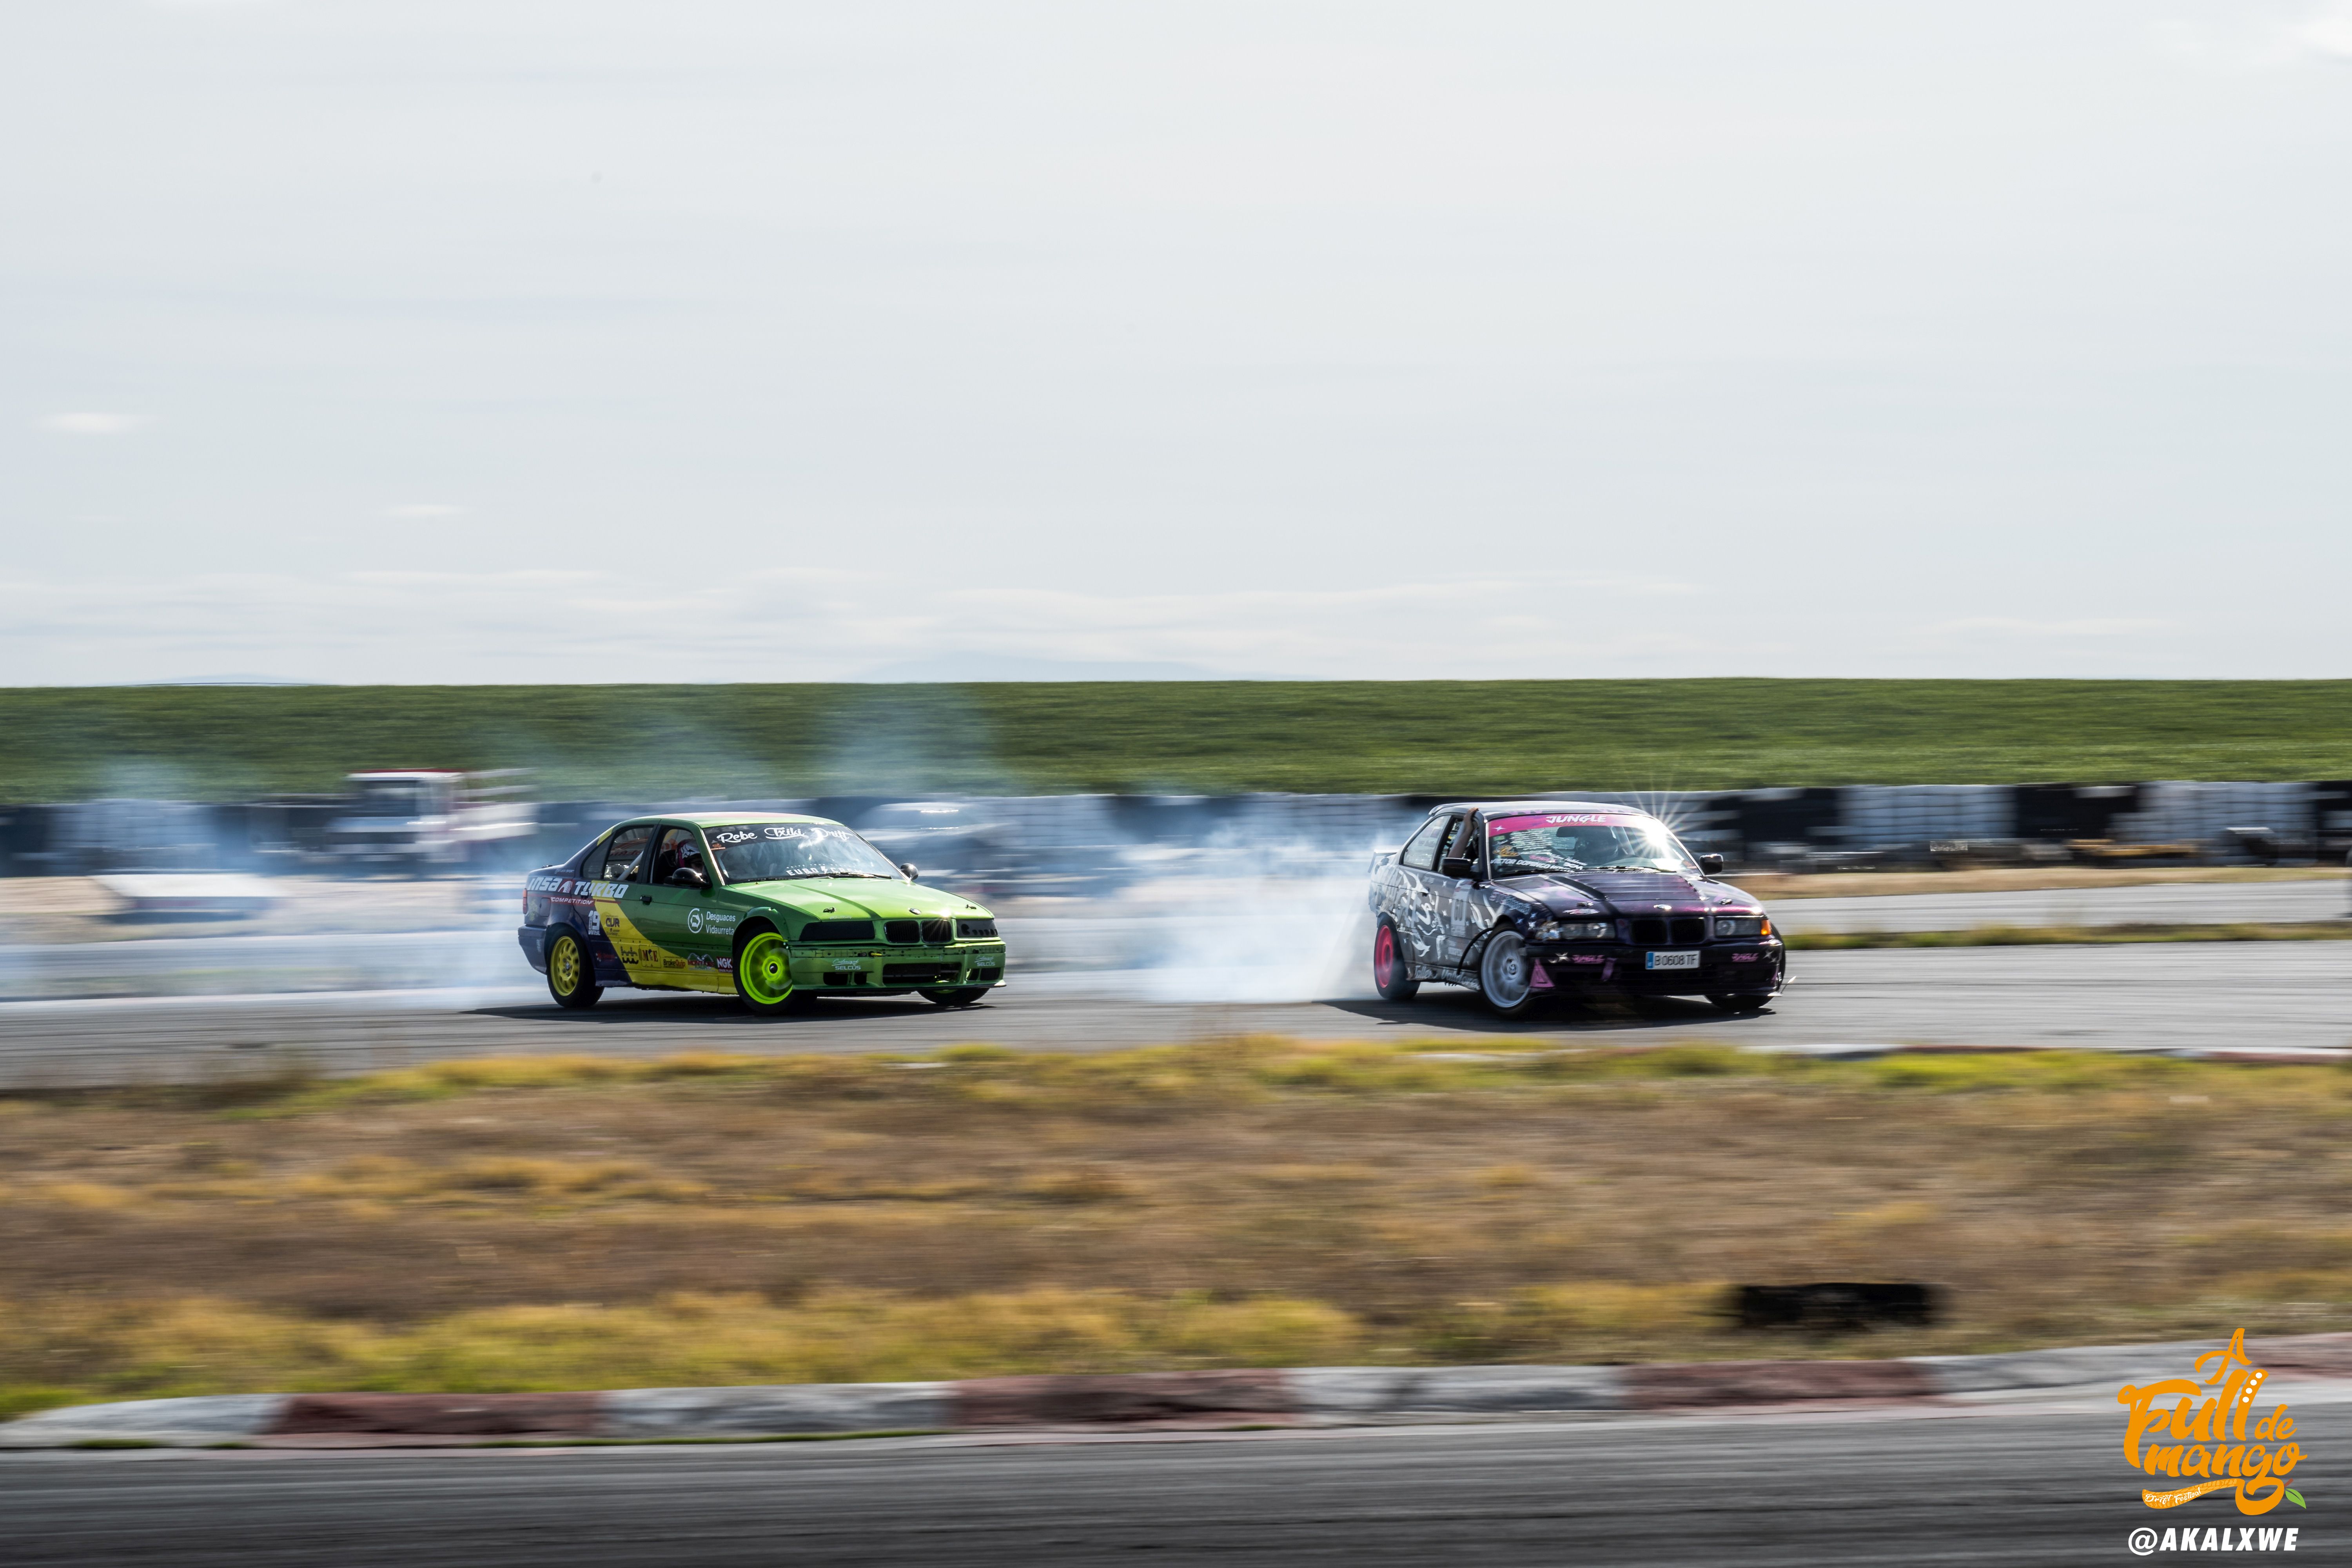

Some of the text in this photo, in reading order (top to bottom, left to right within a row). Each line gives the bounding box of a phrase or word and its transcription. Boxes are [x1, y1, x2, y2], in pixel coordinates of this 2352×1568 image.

[717, 827, 853, 842] Rebe Txiki Drift
[786, 867, 819, 876] EURO
[574, 881, 629, 898] TURBO
[551, 897, 593, 905] COMPETITION
[706, 911, 736, 923] Desguaces
[706, 925, 734, 935] Vidaurreta
[717, 958, 733, 969] NGK
